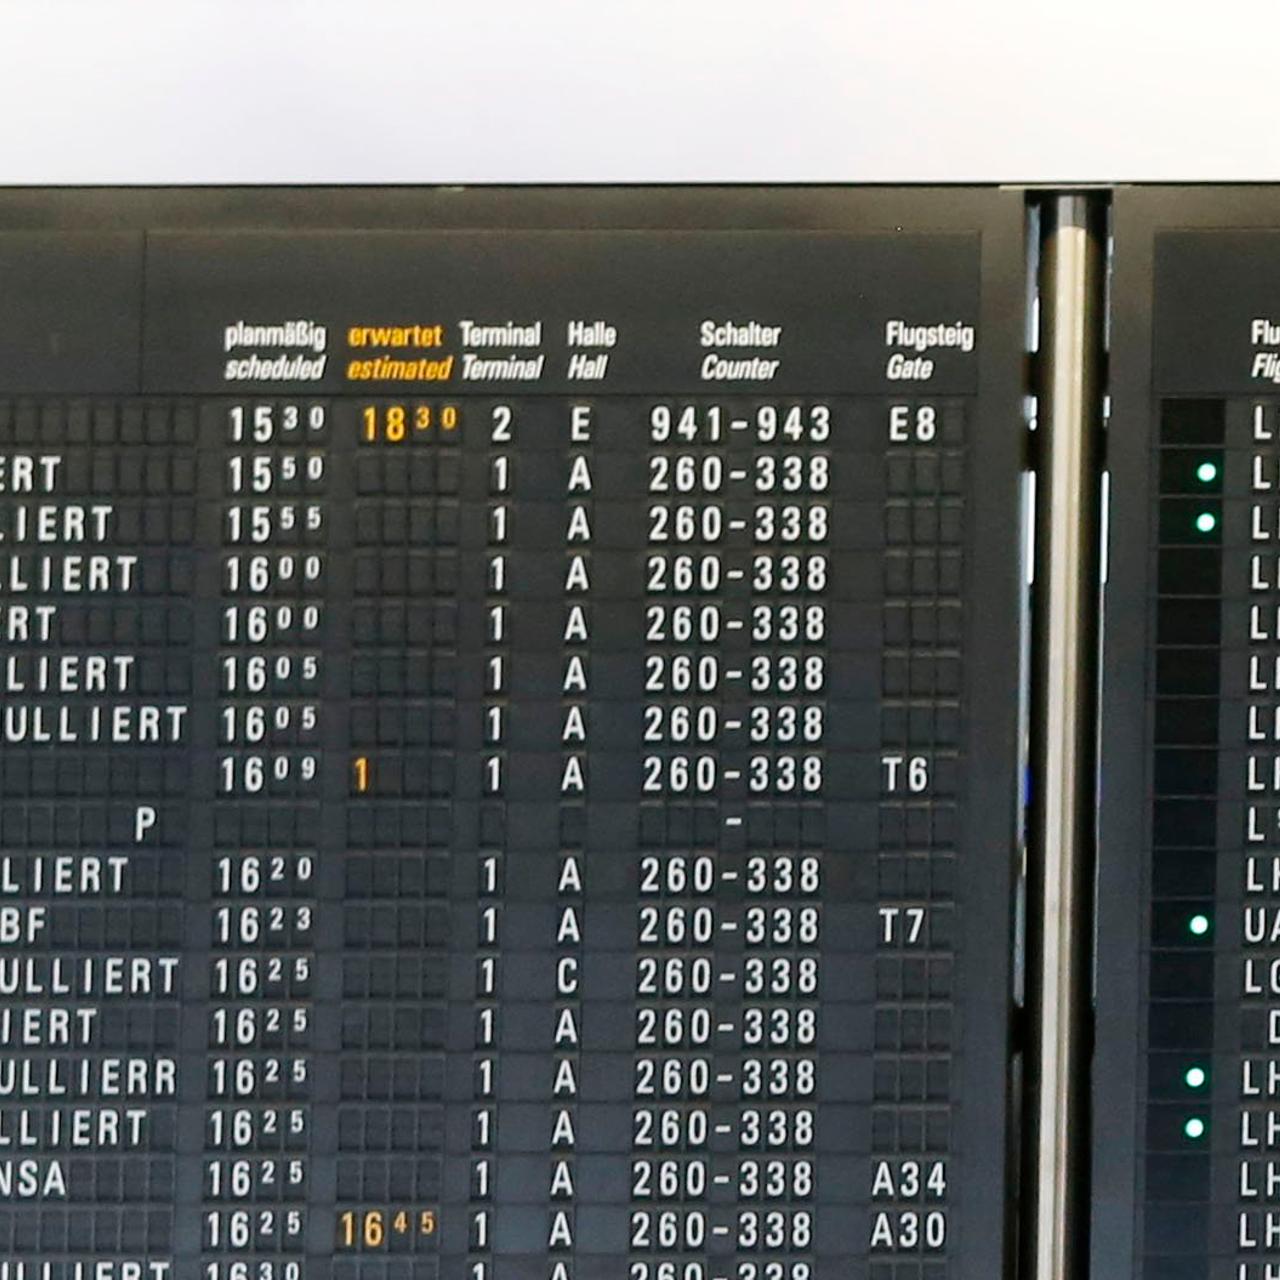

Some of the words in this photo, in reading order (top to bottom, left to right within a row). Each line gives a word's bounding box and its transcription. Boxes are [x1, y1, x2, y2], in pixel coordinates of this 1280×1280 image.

[225, 320, 326, 352] planmäßig
[347, 324, 443, 348] erwartet
[459, 320, 541, 347] Terminal
[568, 320, 616, 347] Halle
[700, 320, 781, 347] Schalter
[886, 320, 974, 352] Flugsteig
[224, 354, 326, 380] scheduled
[347, 354, 451, 380] estimated
[462, 354, 544, 380] Terminal
[568, 354, 608, 380] Hall
[701, 354, 779, 380] Counter
[887, 354, 933, 380] Gate
[652, 406, 829, 441] 941-943
[890, 407, 934, 440] E8
[882, 757, 926, 791] T6
[879, 908, 923, 942] T7
[873, 1162, 945, 1196] A34
[871, 1212, 944, 1247] A30
